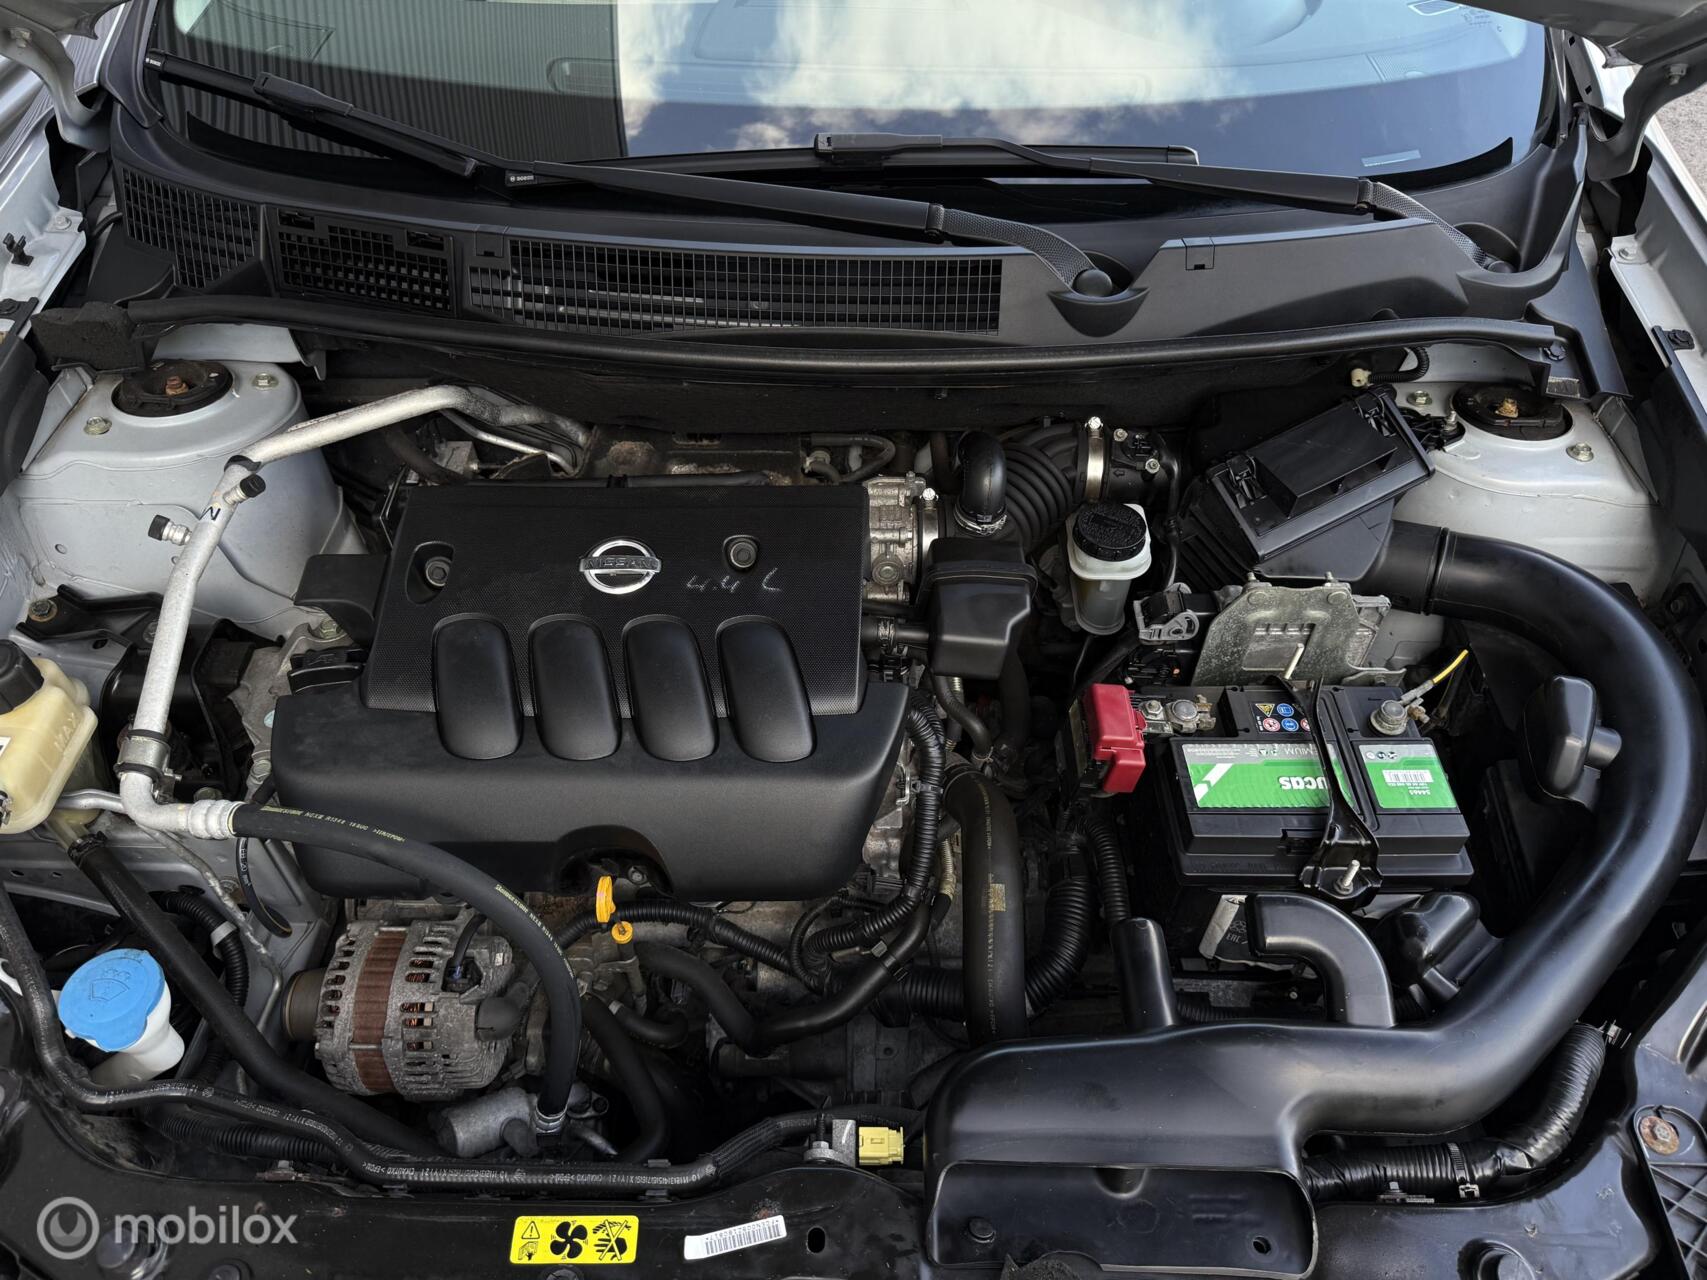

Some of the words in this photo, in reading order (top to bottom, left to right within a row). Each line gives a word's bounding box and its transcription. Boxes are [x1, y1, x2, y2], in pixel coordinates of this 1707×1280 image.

[585, 557, 654, 570] NISSAN
[54, 712, 77, 753] MAX
[1278, 776, 1328, 791] ucas
